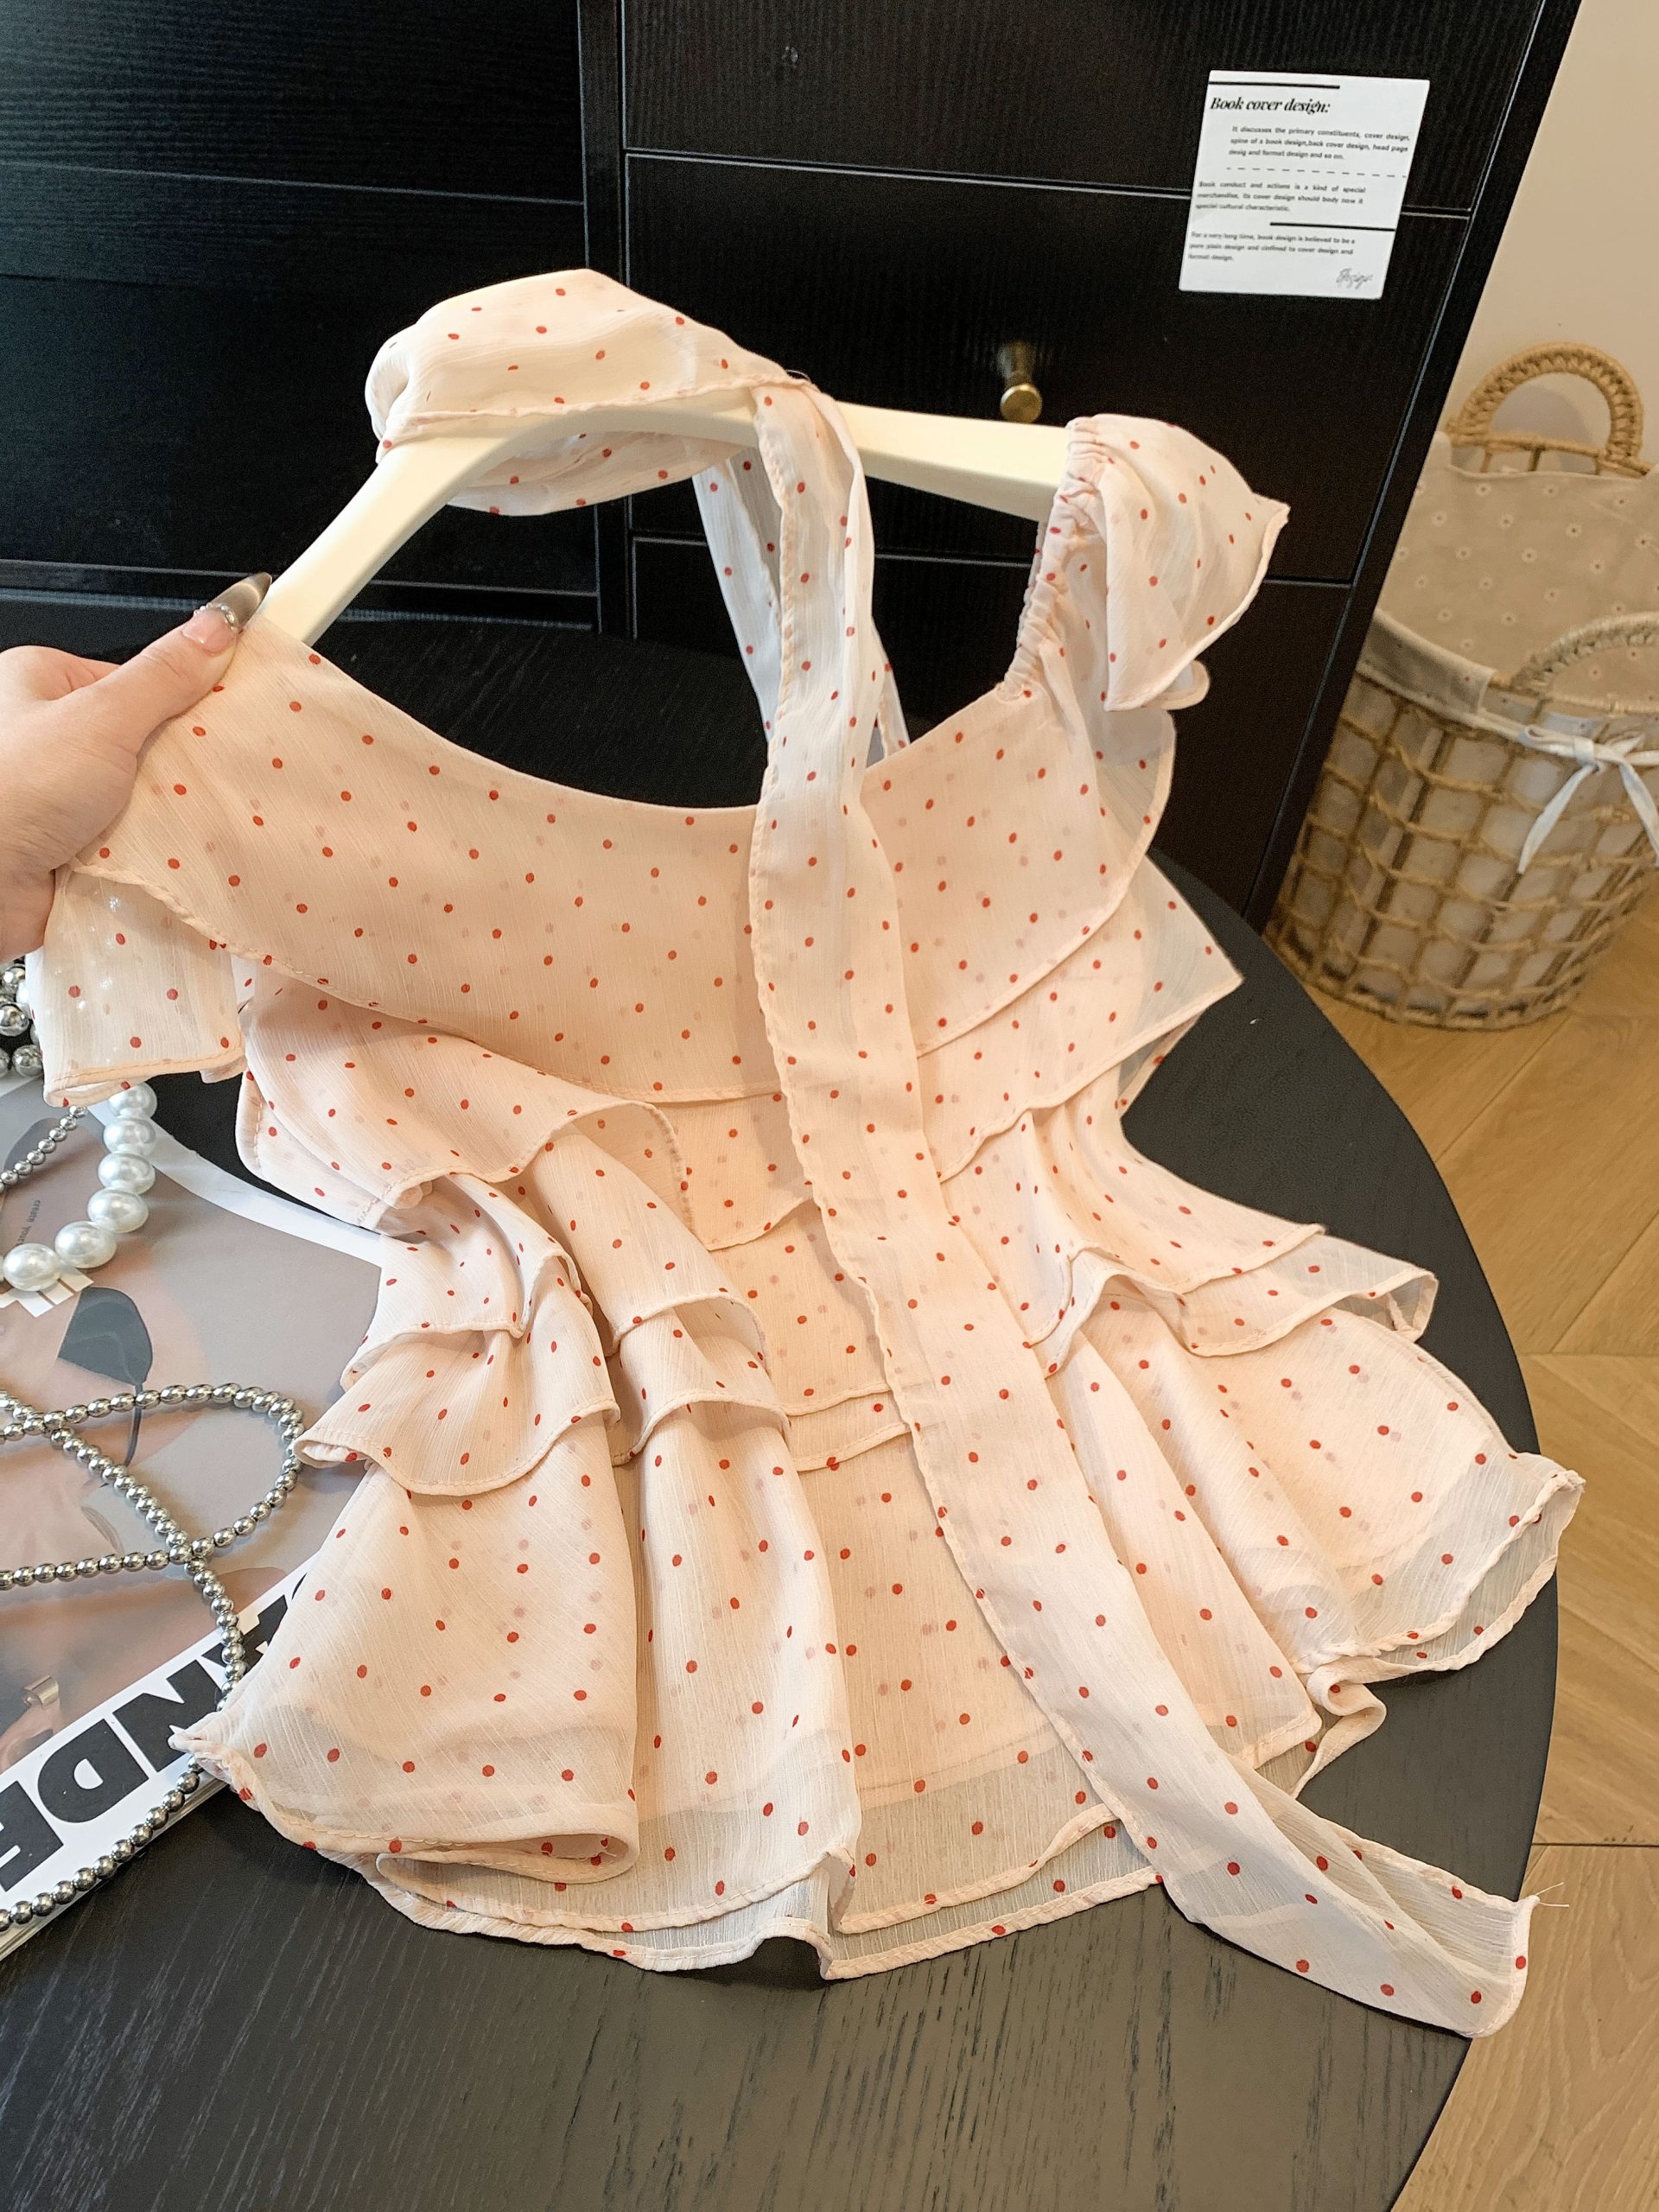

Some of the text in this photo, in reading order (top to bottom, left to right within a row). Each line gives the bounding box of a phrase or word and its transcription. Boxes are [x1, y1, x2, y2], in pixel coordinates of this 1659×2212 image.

[1210, 97, 1331, 115] Book cover design:
[1318, 130, 1361, 138] constituents,
[1386, 133, 1410, 142] design,
[27, 1199, 41, 1223] create
[0, 1573, 307, 1892] ANDE
